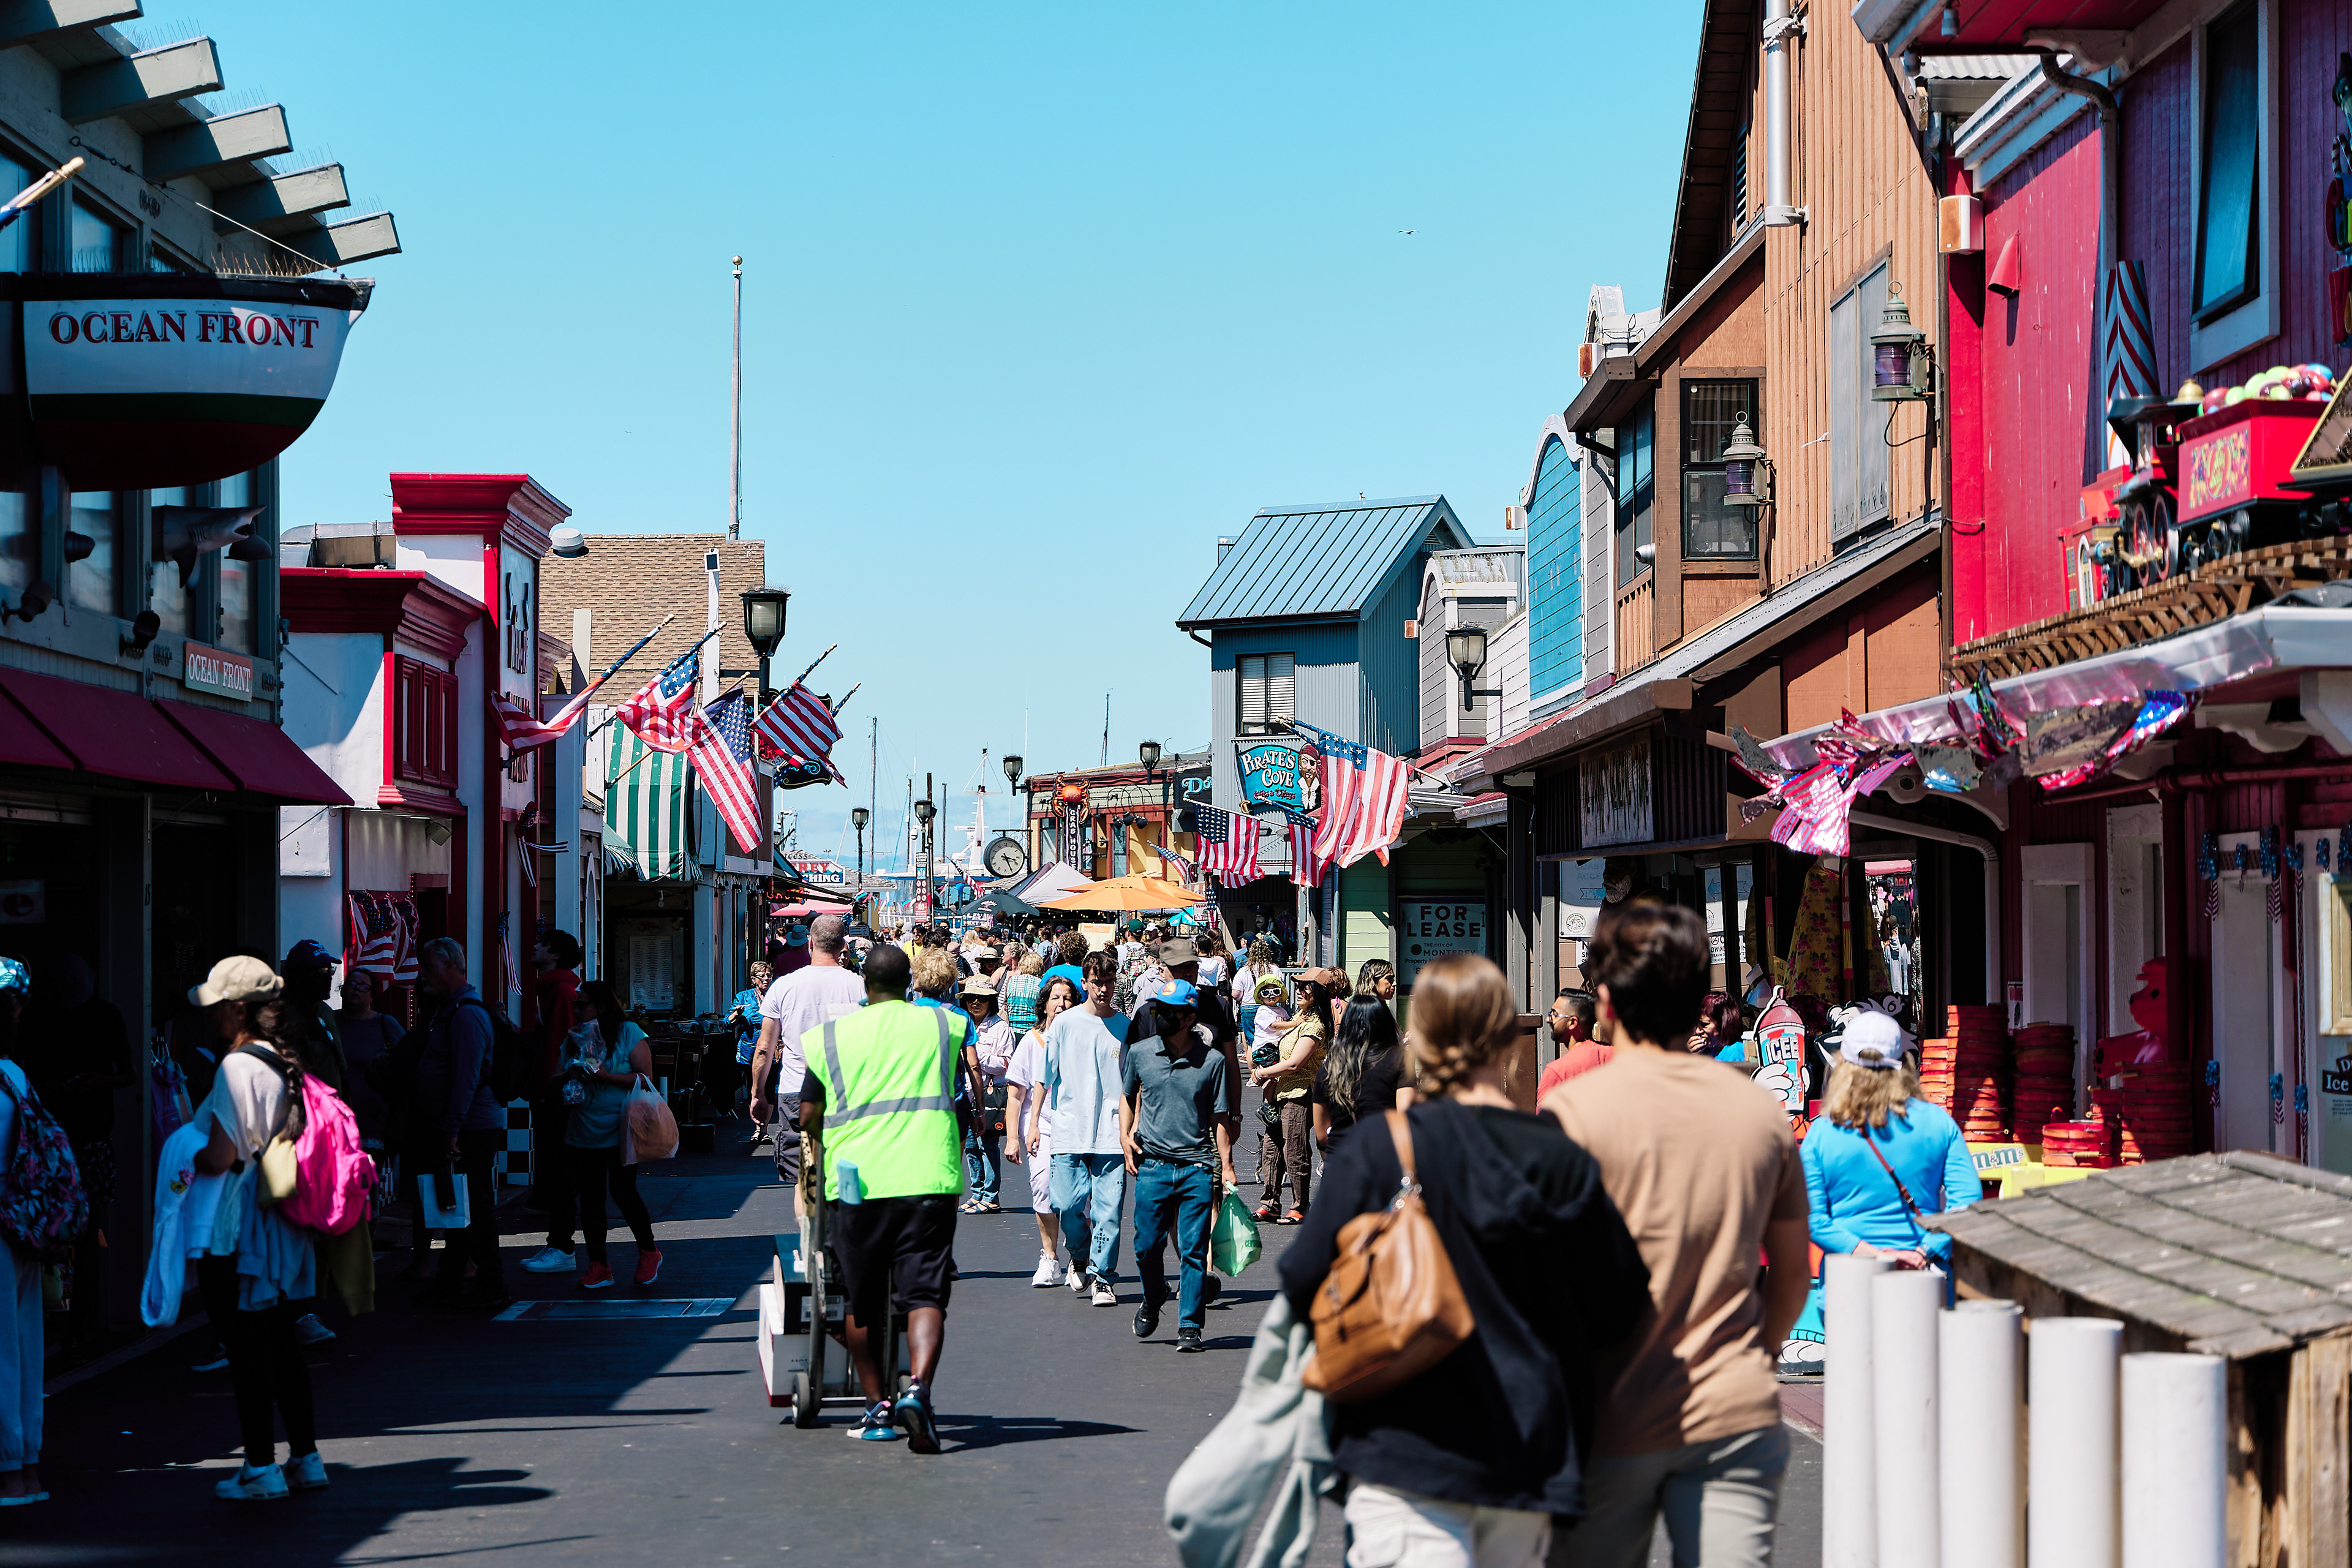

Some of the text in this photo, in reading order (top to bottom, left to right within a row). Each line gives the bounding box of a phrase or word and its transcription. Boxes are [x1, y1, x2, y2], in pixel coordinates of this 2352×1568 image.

[48, 310, 319, 348] OCEAN FRONT
[188, 653, 251, 692] OCEAN FRONT
[1240, 748, 1296, 776] PIRATE'S
[1261, 767, 1295, 788] COVE
[1420, 905, 1468, 921] FOR
[1406, 922, 1481, 938] LEASE
[1765, 1036, 1800, 1064] ICEE
[2340, 1059, 2352, 1072] D
[2326, 1074, 2350, 1091] Ice
